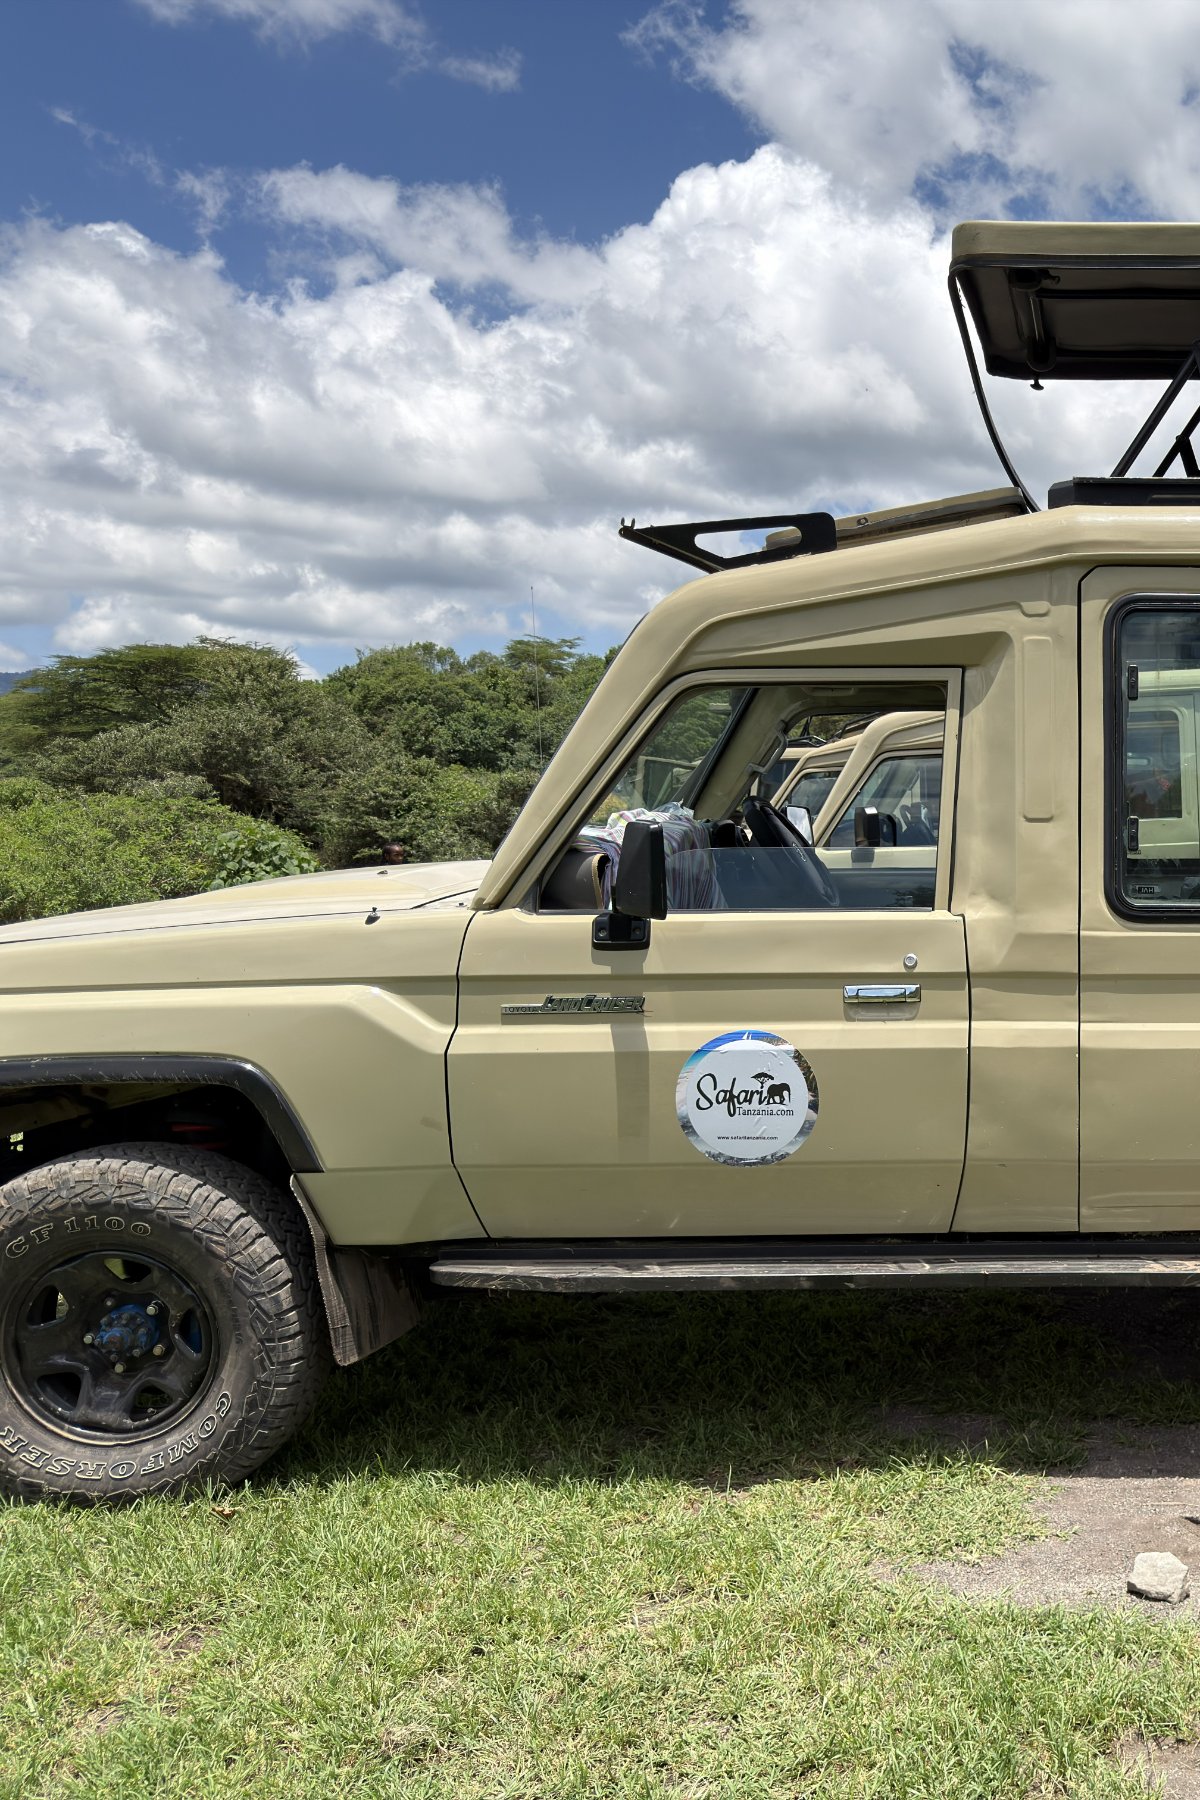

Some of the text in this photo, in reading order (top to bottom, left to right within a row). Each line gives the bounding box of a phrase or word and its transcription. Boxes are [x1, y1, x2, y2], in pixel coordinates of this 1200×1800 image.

[695, 1073, 767, 1117] Safari
[737, 1106, 794, 1117] Tanzania.com
[5, 1215, 152, 1259] CF 1100
[0, 1391, 232, 1480] COMFORSER
